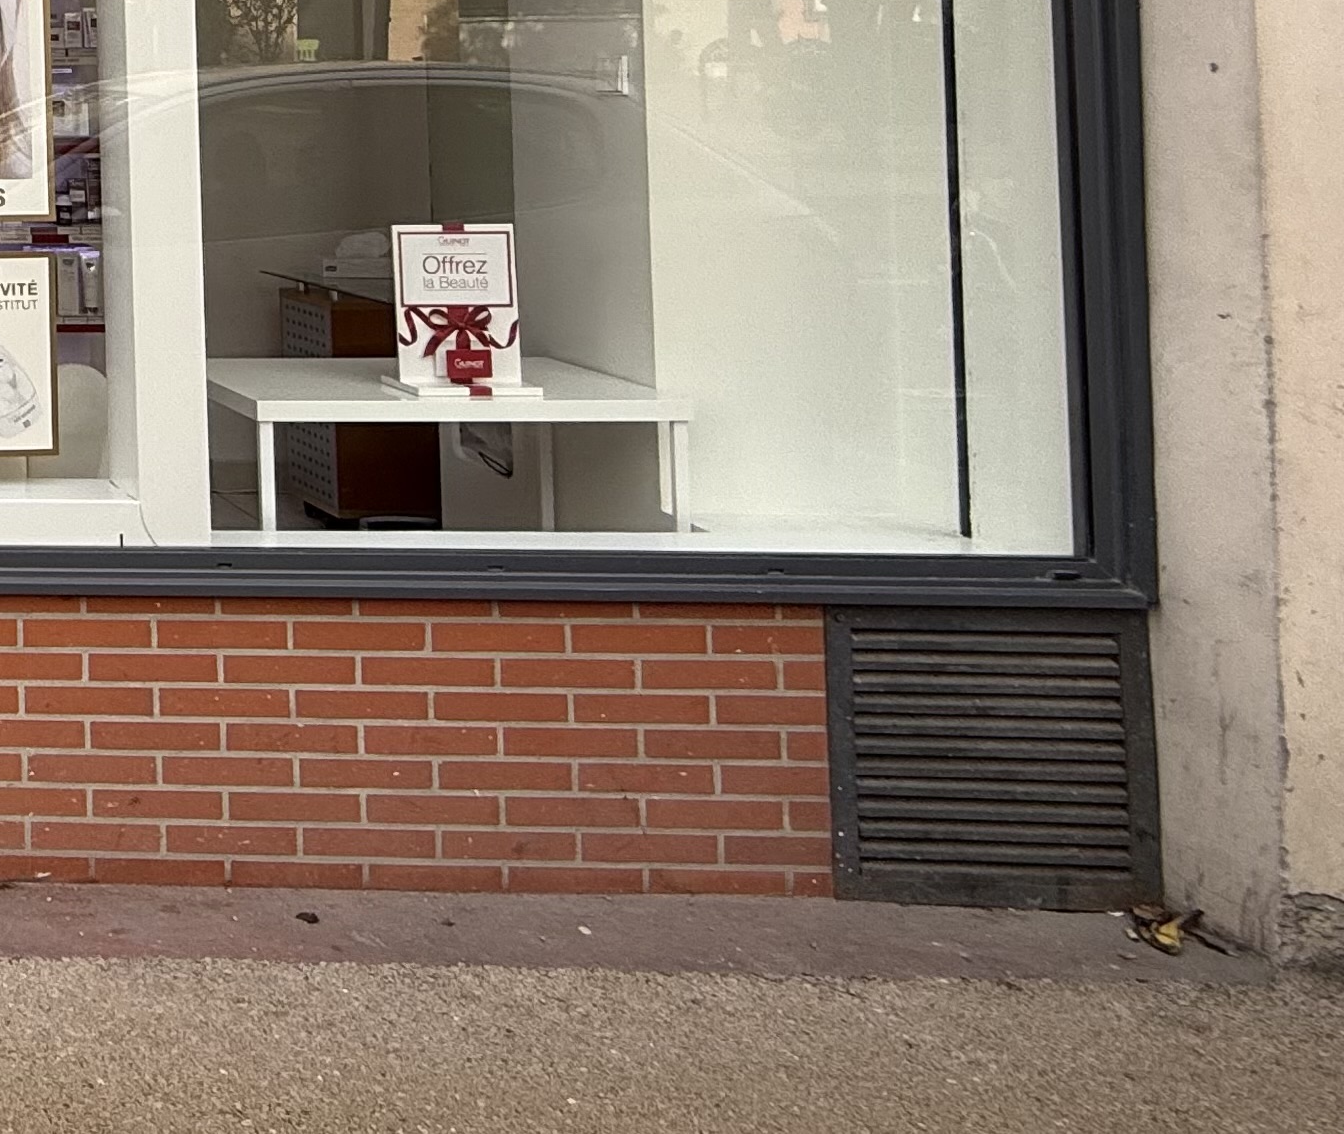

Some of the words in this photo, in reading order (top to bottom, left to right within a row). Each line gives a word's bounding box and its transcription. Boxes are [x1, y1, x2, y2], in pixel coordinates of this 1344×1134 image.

[423, 255, 488, 274] Offrez
[423, 276, 435, 289] la
[439, 276, 488, 289] Beauté
